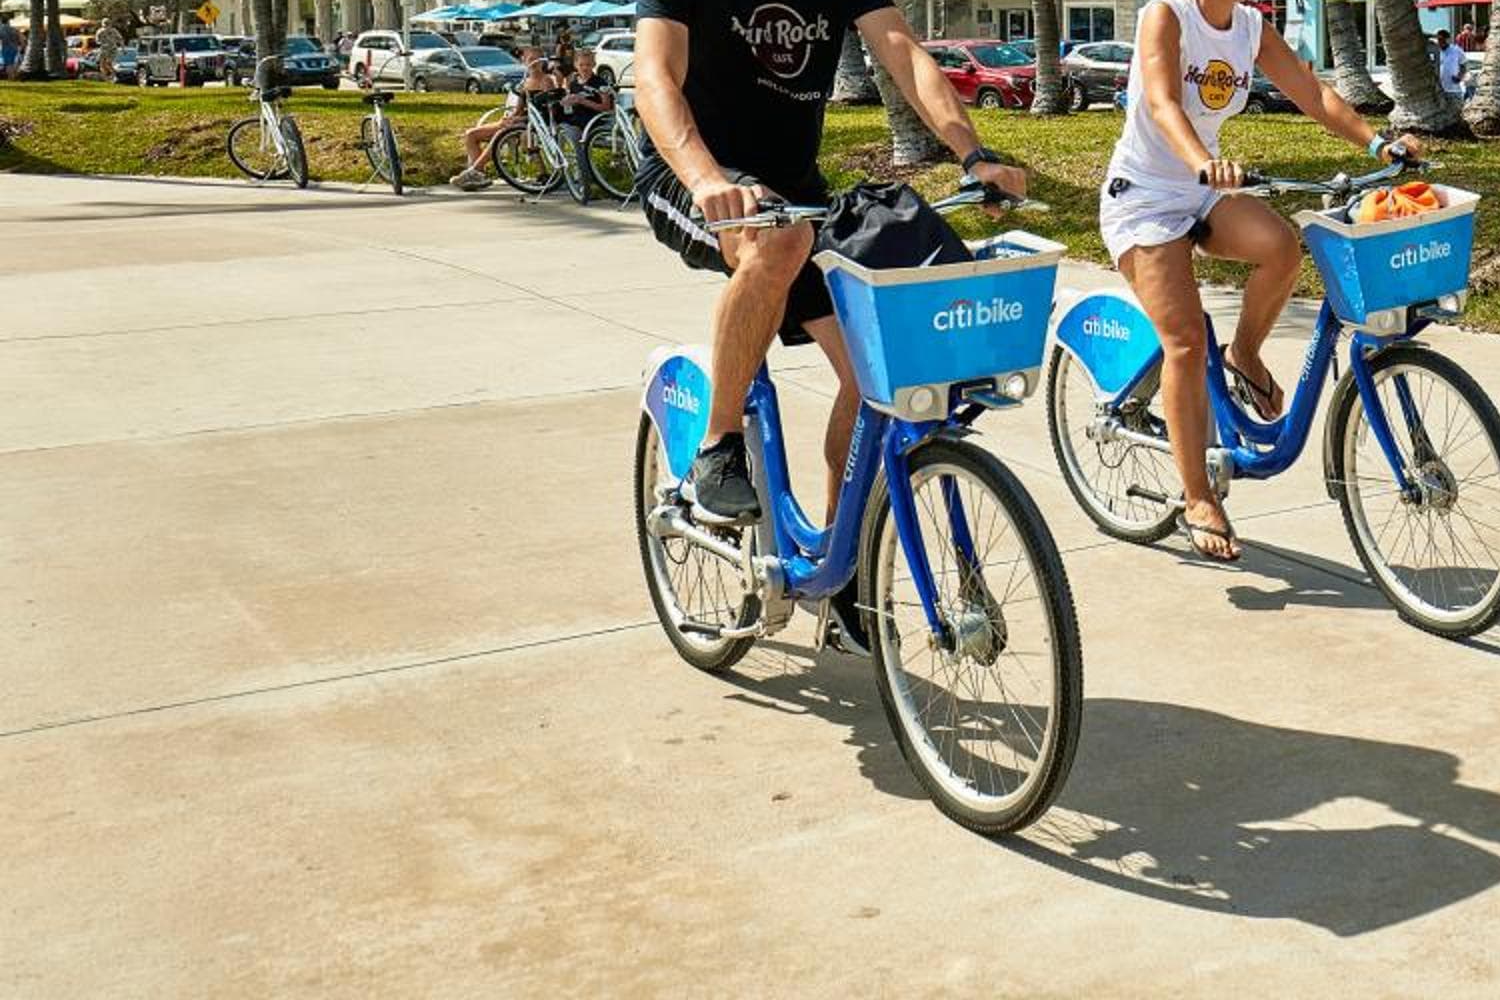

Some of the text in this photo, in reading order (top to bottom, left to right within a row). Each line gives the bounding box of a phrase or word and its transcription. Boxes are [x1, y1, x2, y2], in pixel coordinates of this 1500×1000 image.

[775, 14, 831, 50] Rock
[1390, 241, 1451, 269] citi bike
[933, 298, 1024, 331] citi bike
[1103, 319, 1131, 342] bike
